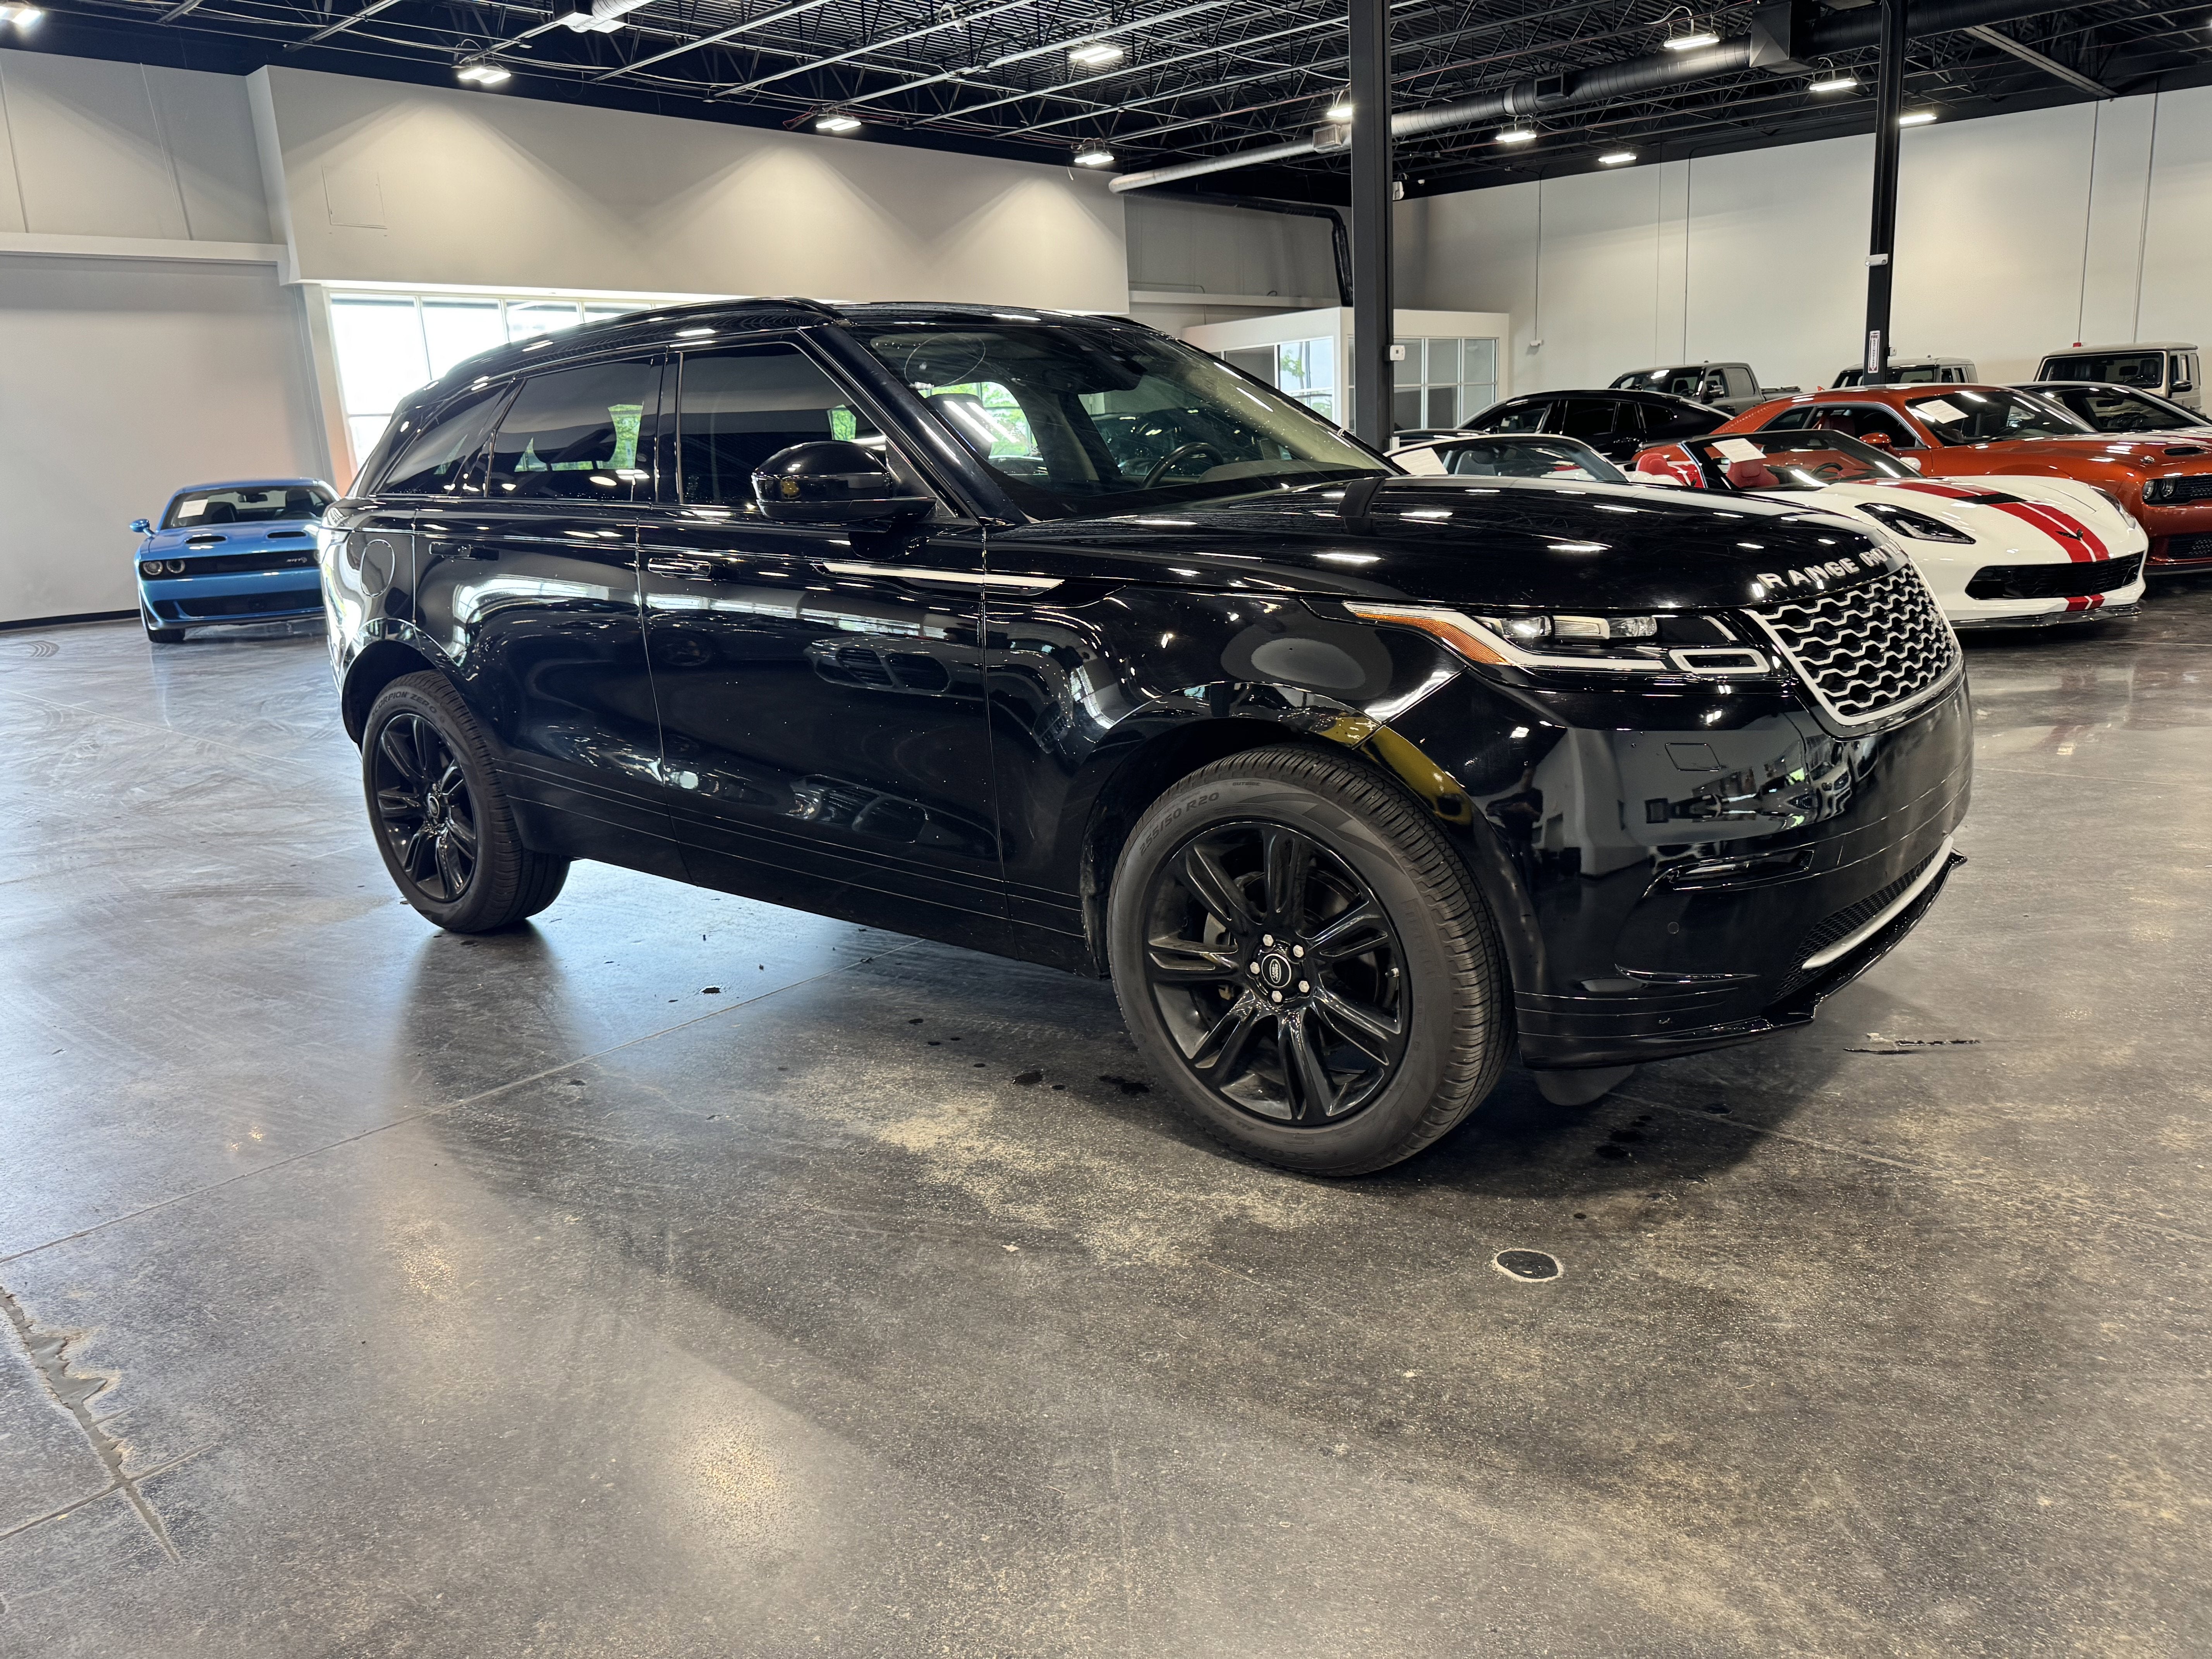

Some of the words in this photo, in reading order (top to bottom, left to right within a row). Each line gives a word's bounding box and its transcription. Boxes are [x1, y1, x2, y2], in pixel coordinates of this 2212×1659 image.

[1757, 558, 1860, 589] RANGE
[410, 694, 437, 713] ZERO
[1140, 808, 1182, 856] 255/50
[1186, 792, 1219, 812] R20
